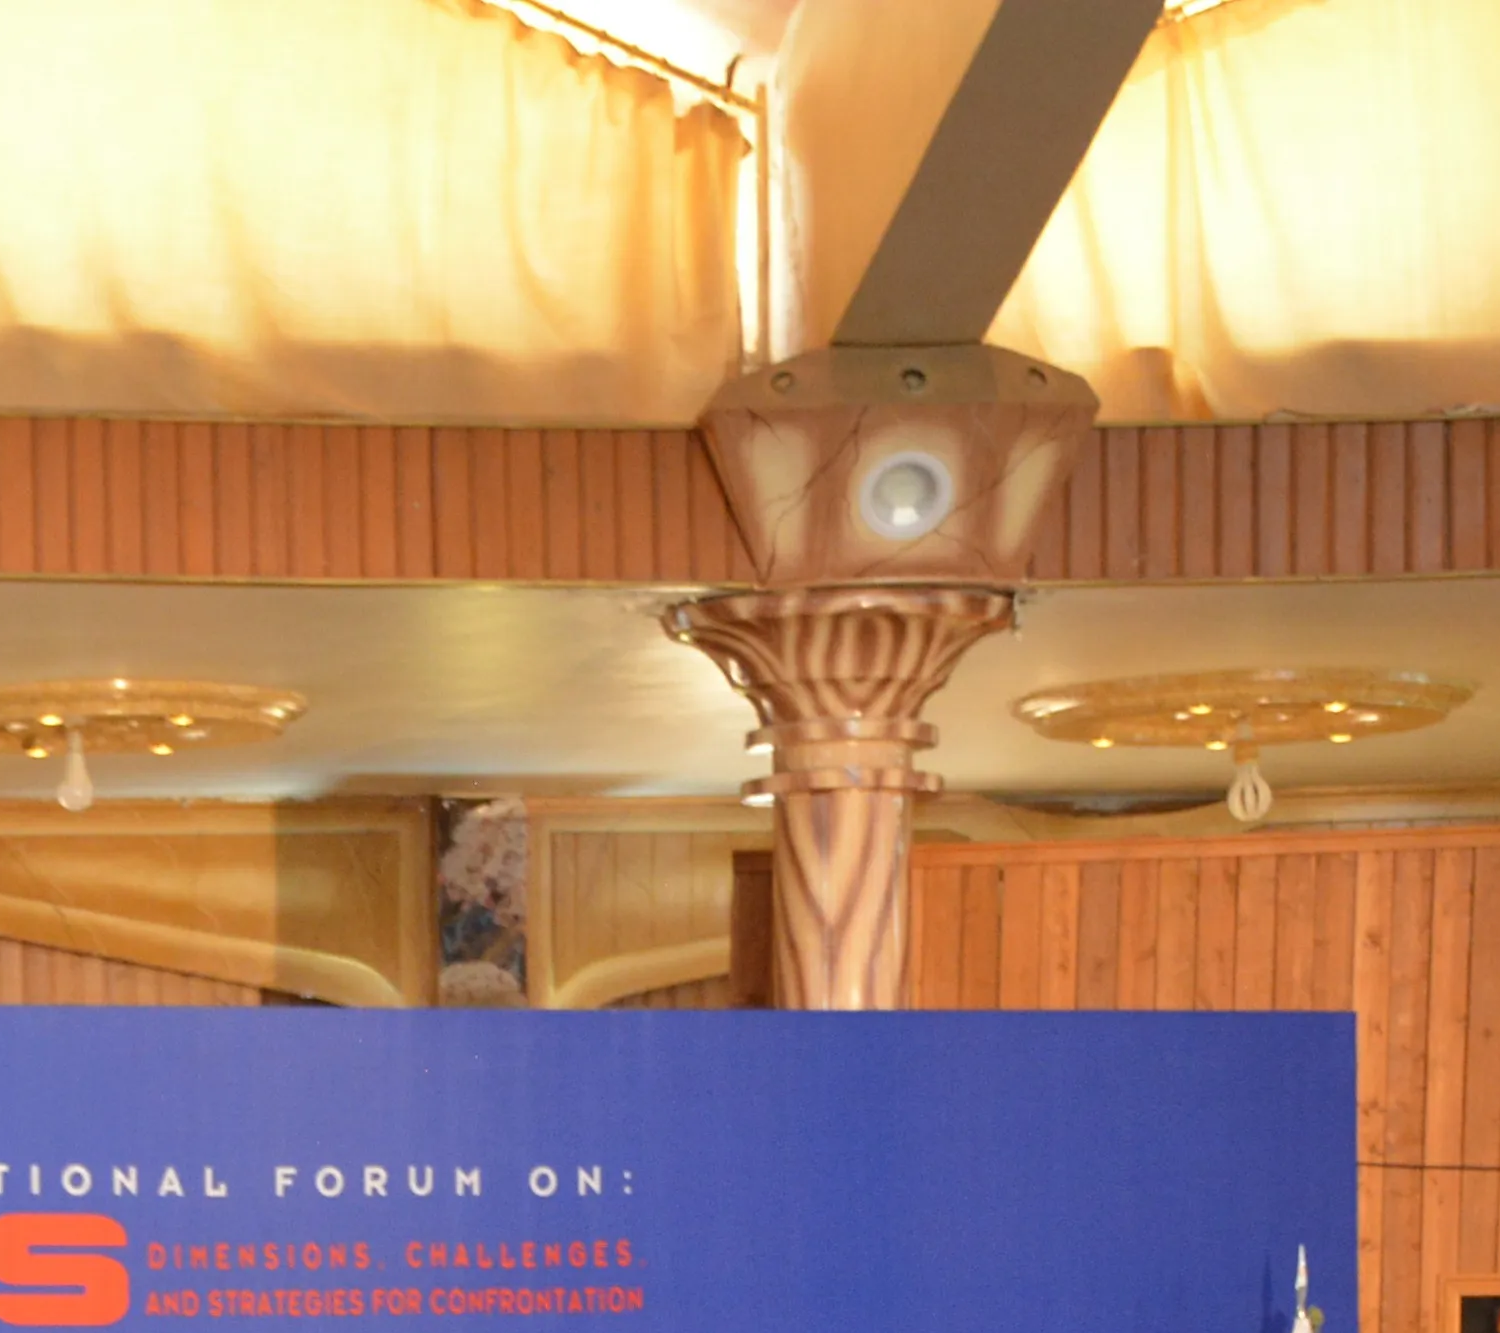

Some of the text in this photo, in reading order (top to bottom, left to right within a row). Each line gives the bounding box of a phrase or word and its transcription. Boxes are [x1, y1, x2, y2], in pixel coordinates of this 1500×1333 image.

[274, 1165, 482, 1198] FORUM
[528, 1165, 634, 1198] ON:
[145, 1286, 644, 1317] AND STRATEGIES FOR CONFRONTATION
